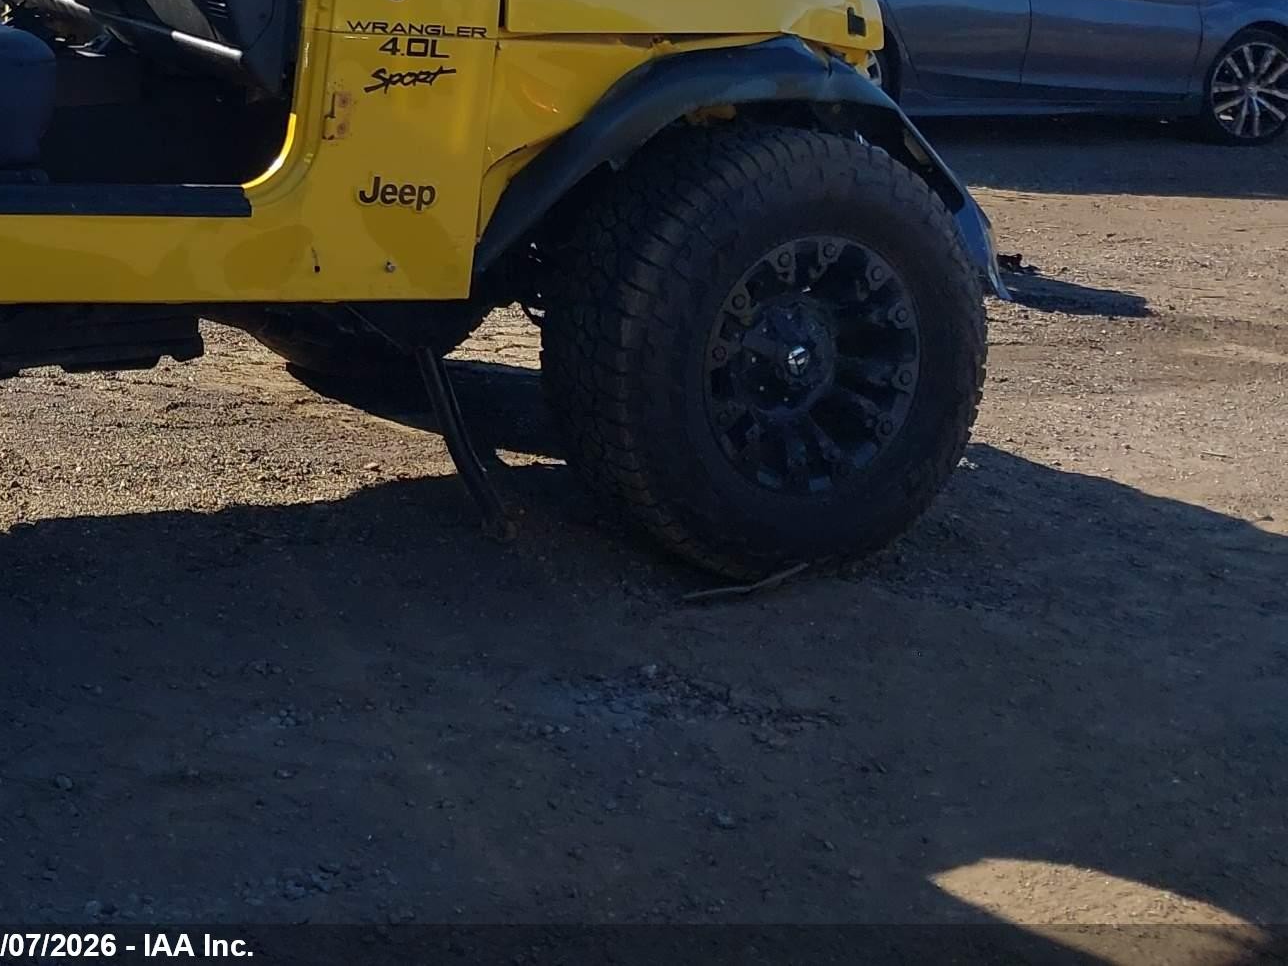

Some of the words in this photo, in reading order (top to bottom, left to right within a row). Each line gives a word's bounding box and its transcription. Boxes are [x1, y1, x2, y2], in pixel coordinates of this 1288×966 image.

[347, 20, 487, 38] WRANGLER
[379, 36, 450, 59] 4.0L
[359, 176, 436, 211] Jeep
